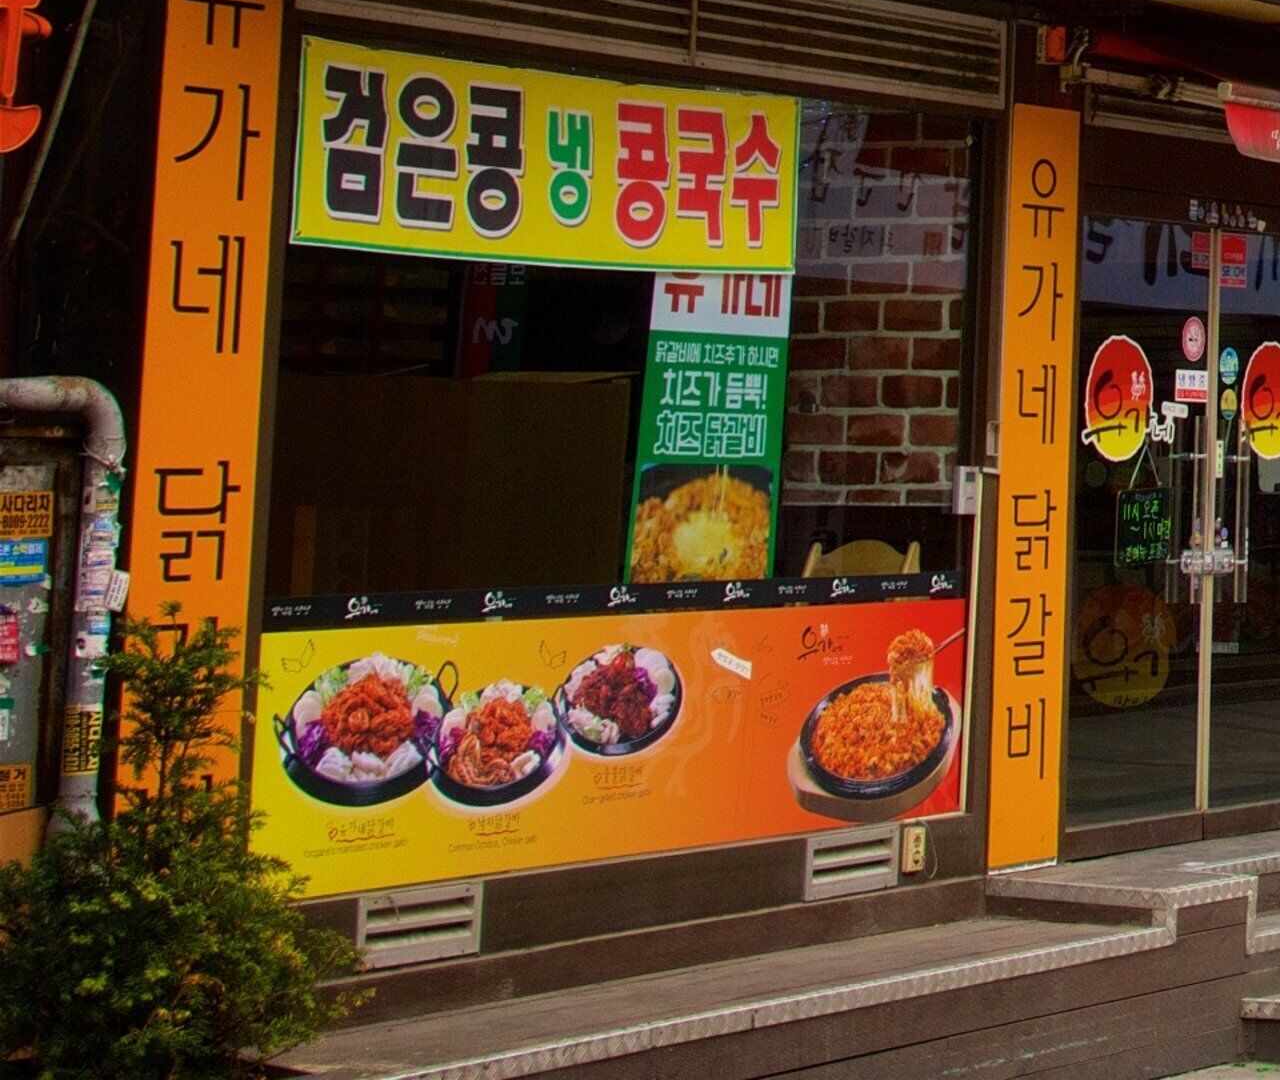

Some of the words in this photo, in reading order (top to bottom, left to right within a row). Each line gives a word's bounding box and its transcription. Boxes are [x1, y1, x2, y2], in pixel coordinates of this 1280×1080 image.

[321, 62, 525, 240] 검은콩
[1011, 157, 1066, 446] 유가네
[654, 410, 703, 457] 치즈
[703, 414, 768, 459] 닭갈비
[660, 371, 721, 407] 치즈가
[0, 495, 51, 512] 사다리차
[1005, 488, 1058, 782] 닭갈비
